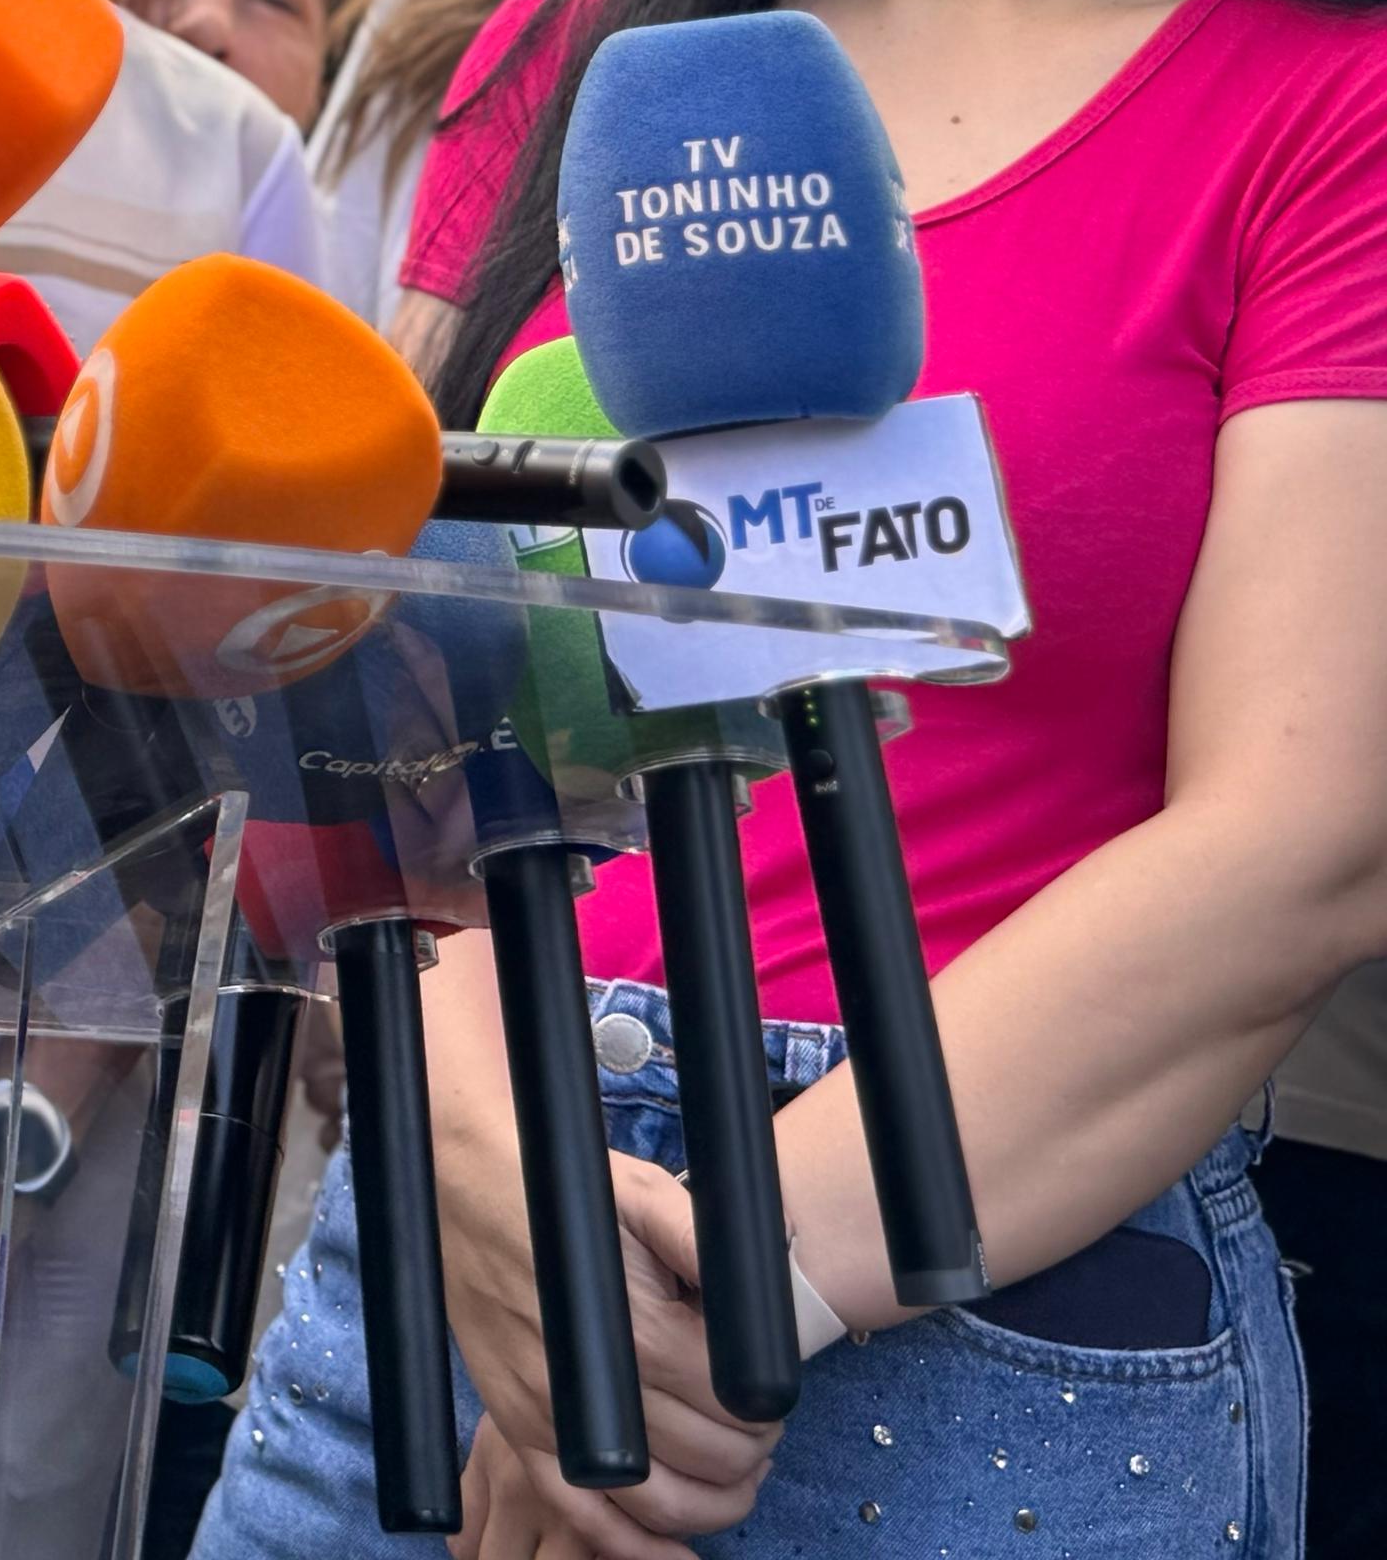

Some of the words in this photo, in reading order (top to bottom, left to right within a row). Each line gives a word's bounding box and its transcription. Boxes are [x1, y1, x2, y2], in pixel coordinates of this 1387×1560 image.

[683, 135, 740, 172] TV
[615, 173, 831, 223] TONINHO
[615, 227, 664, 266] DE
[683, 214, 848, 257] SOUZA
[727, 481, 823, 550] MT
[814, 496, 835, 512] DE
[817, 496, 971, 573] FATO
